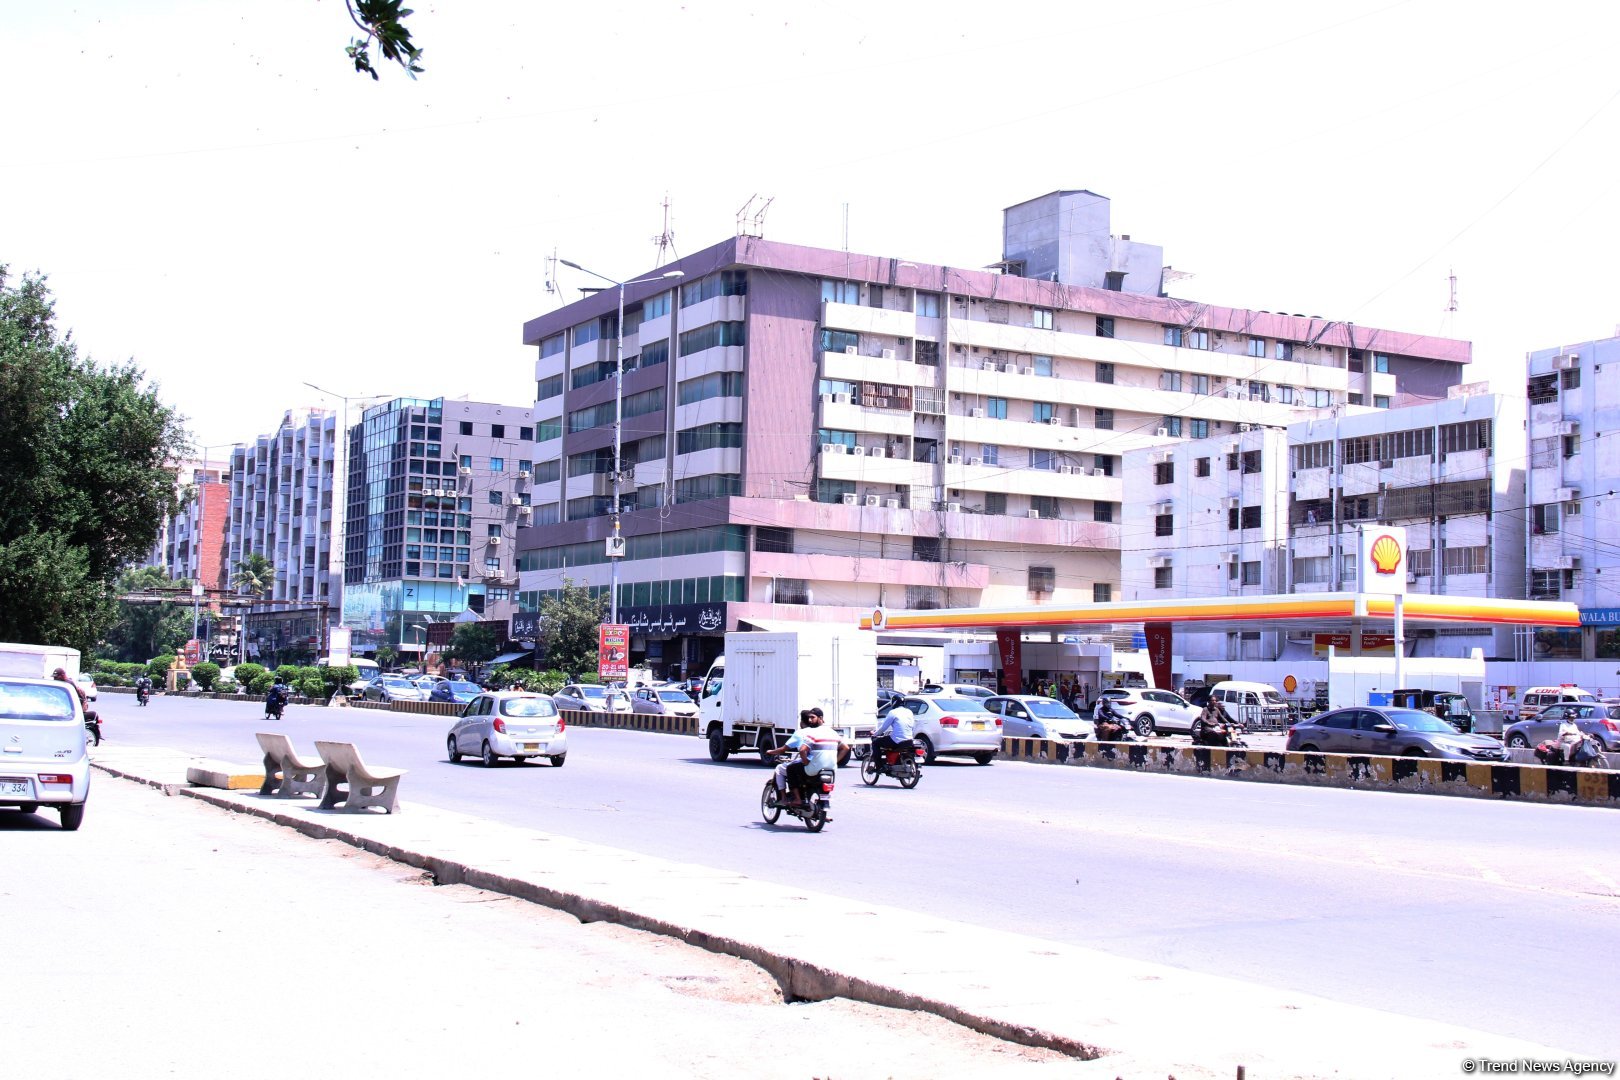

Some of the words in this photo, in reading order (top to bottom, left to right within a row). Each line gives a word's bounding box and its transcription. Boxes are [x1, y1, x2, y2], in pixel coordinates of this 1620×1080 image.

[1581, 612, 1607, 622] WALA
[209, 647, 241, 656] MEG
[11, 783, 26, 793] 334
